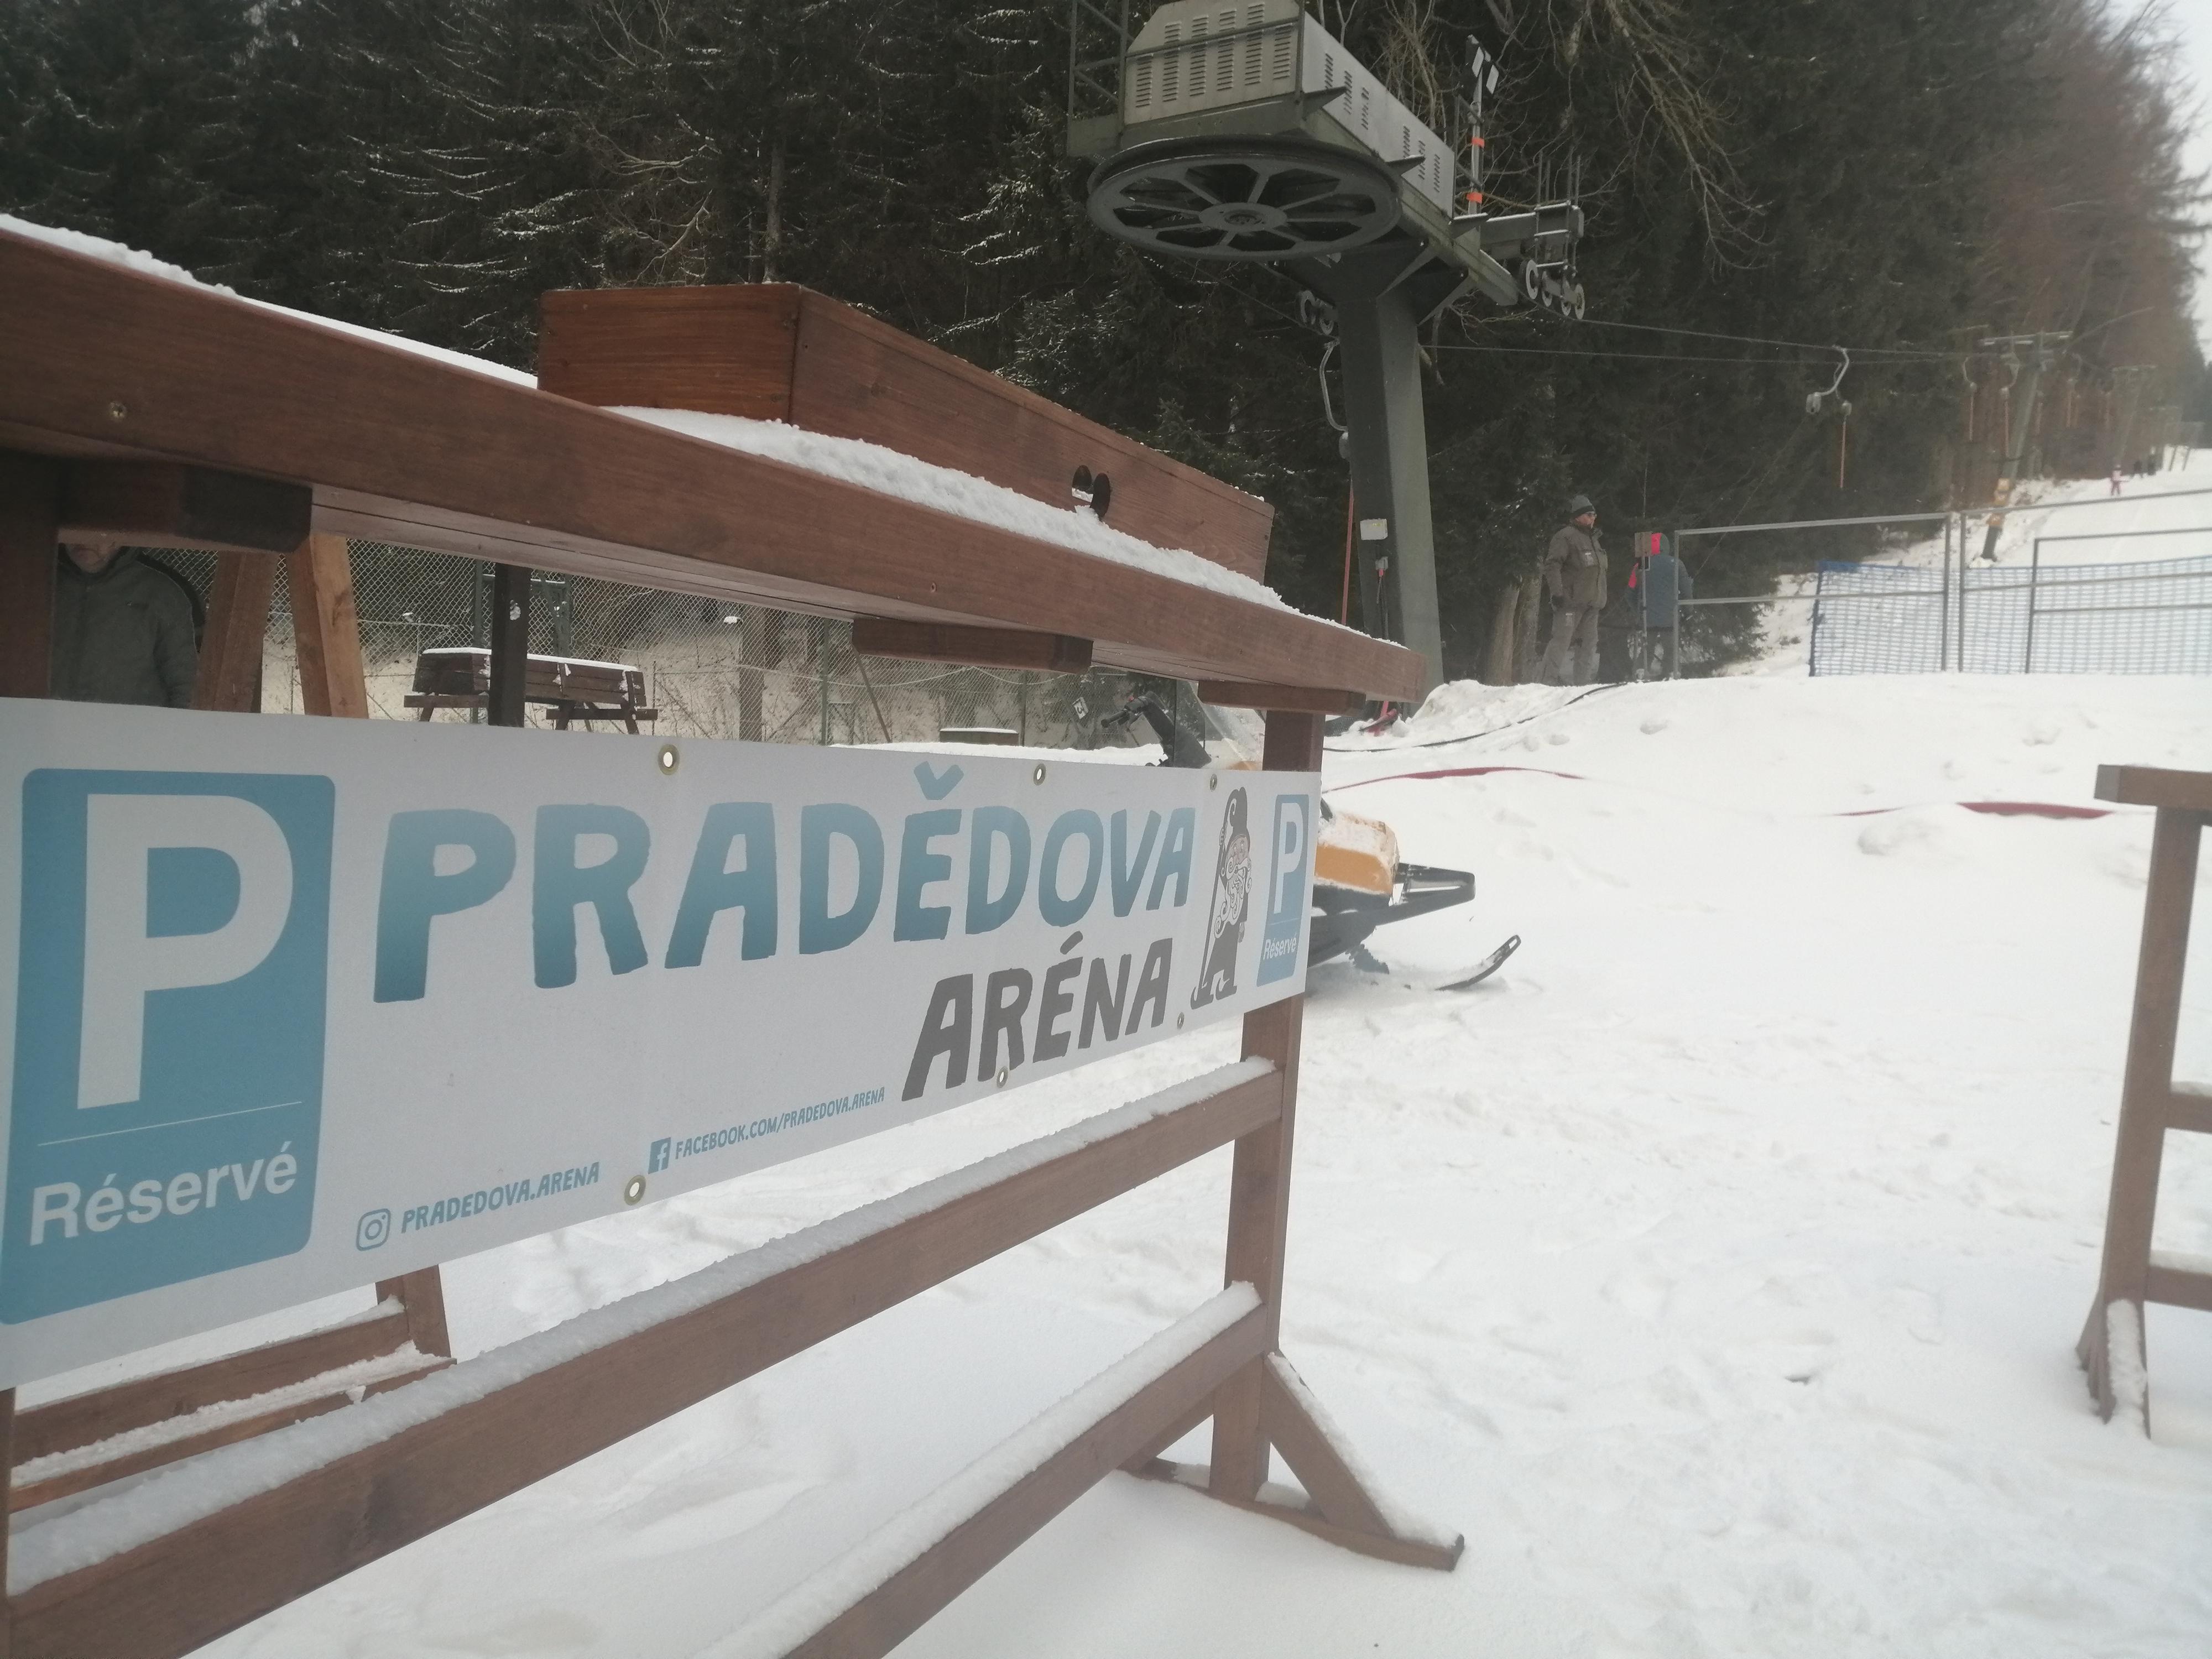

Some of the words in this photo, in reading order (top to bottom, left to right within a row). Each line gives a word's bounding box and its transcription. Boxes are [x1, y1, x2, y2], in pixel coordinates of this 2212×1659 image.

[373, 761, 1196, 1003] PRADĚDOVA
[1273, 802, 1303, 915] P
[77, 793, 294, 1109] P
[1262, 932, 1297, 961] Réservé
[901, 931, 1173, 1102] ARÉNA
[675, 1086, 885, 1160] FACEBOOK.COM/PRADEDOVA.ARENA
[29, 1141, 298, 1246] Réservé
[401, 1161, 601, 1234] PRADEDOVA.ARENA
